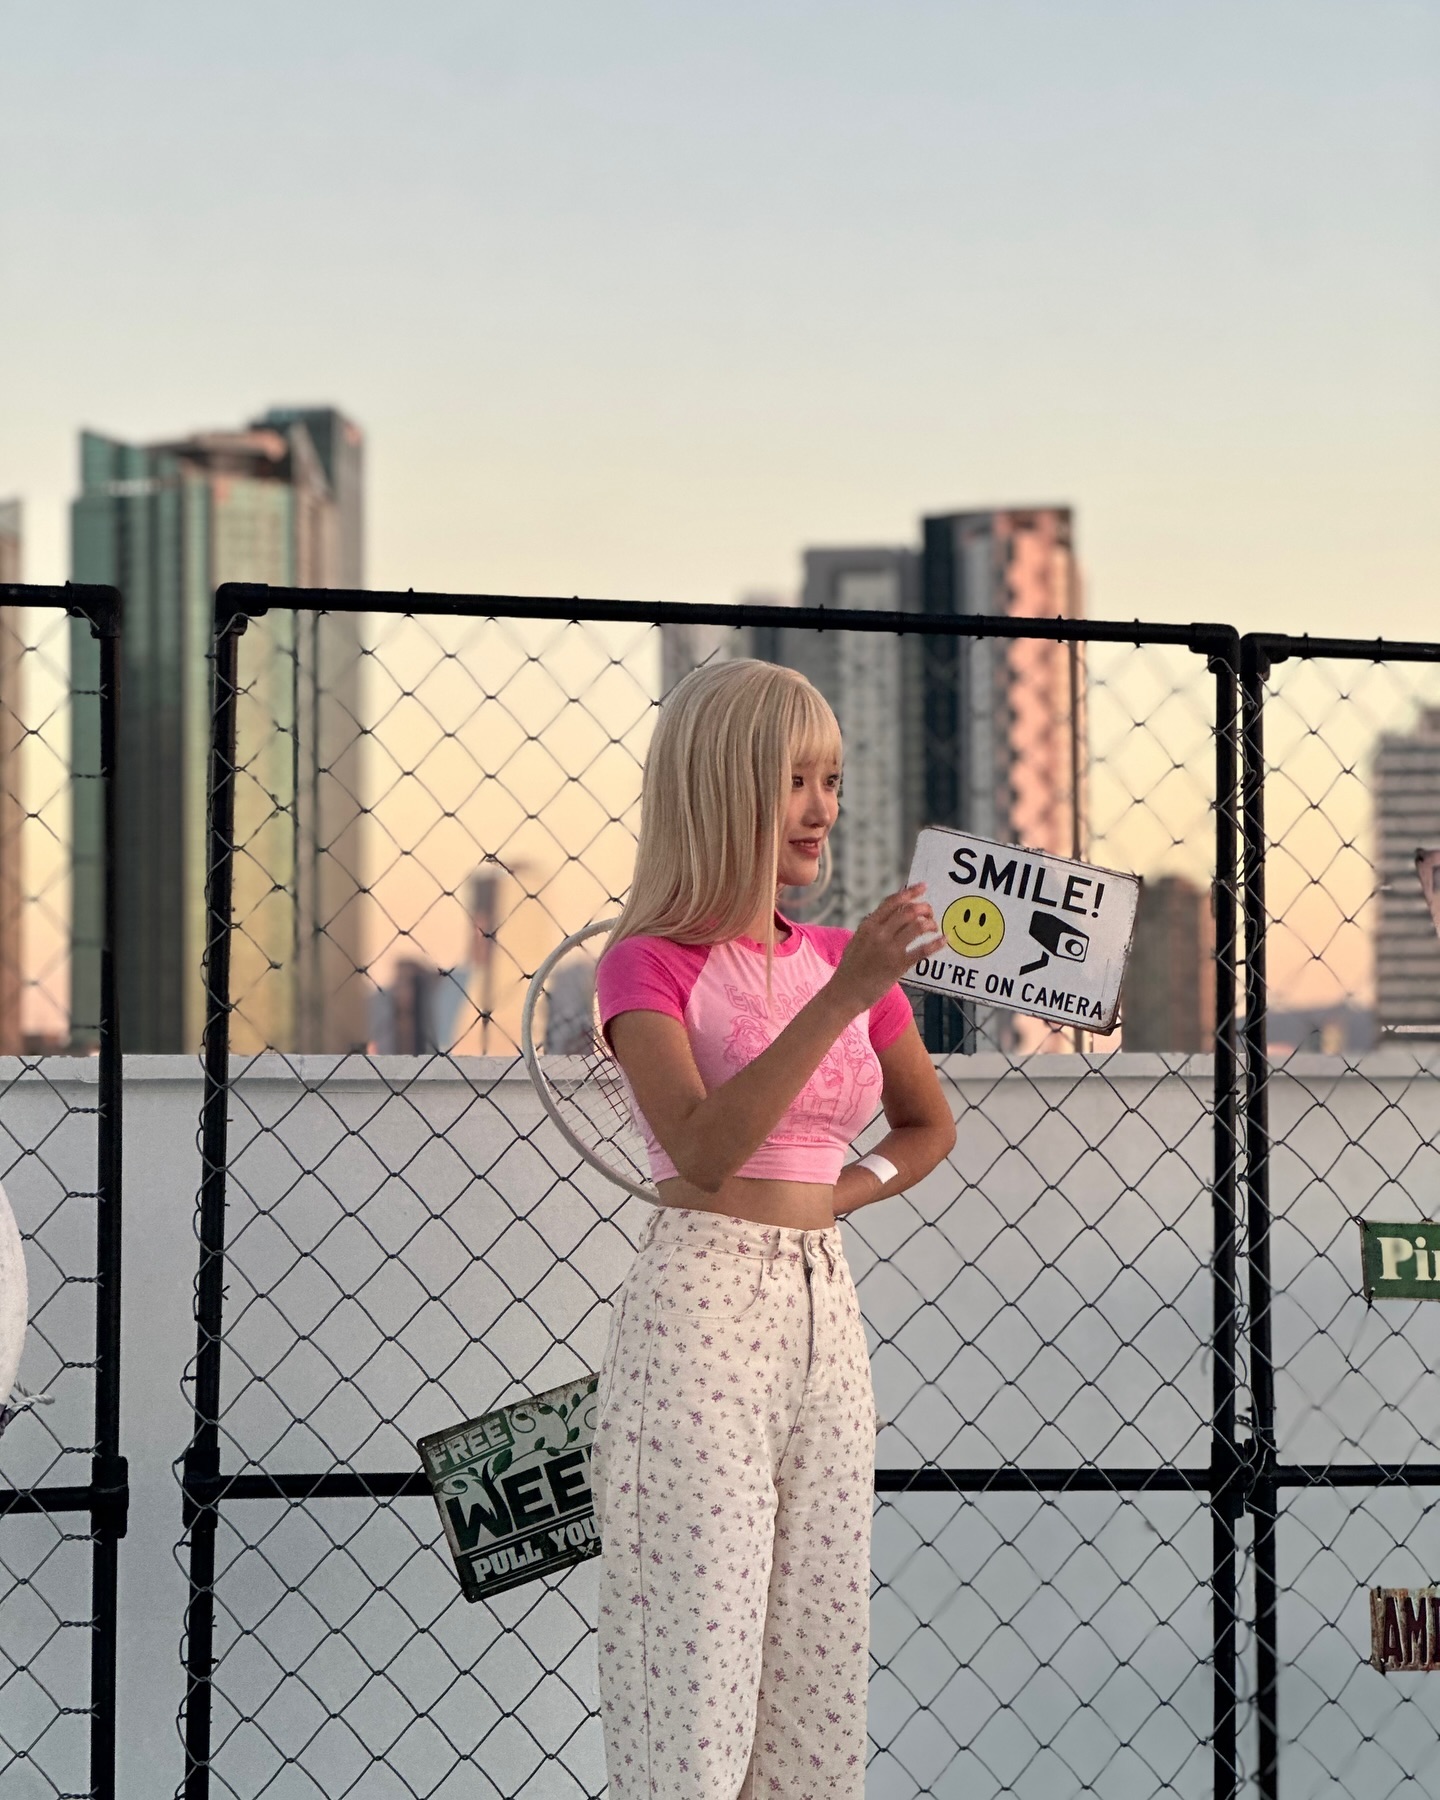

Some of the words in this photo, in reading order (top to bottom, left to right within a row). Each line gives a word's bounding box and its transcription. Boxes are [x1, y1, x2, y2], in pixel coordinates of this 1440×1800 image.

[948, 847, 1106, 919] SMILE!
[915, 957, 980, 990] OU'RE
[985, 973, 1015, 998] ON
[1021, 982, 1103, 1021] CAMERA
[427, 1416, 509, 1475] FREE
[444, 1447, 594, 1552] WEE
[471, 1540, 544, 1584] PULL
